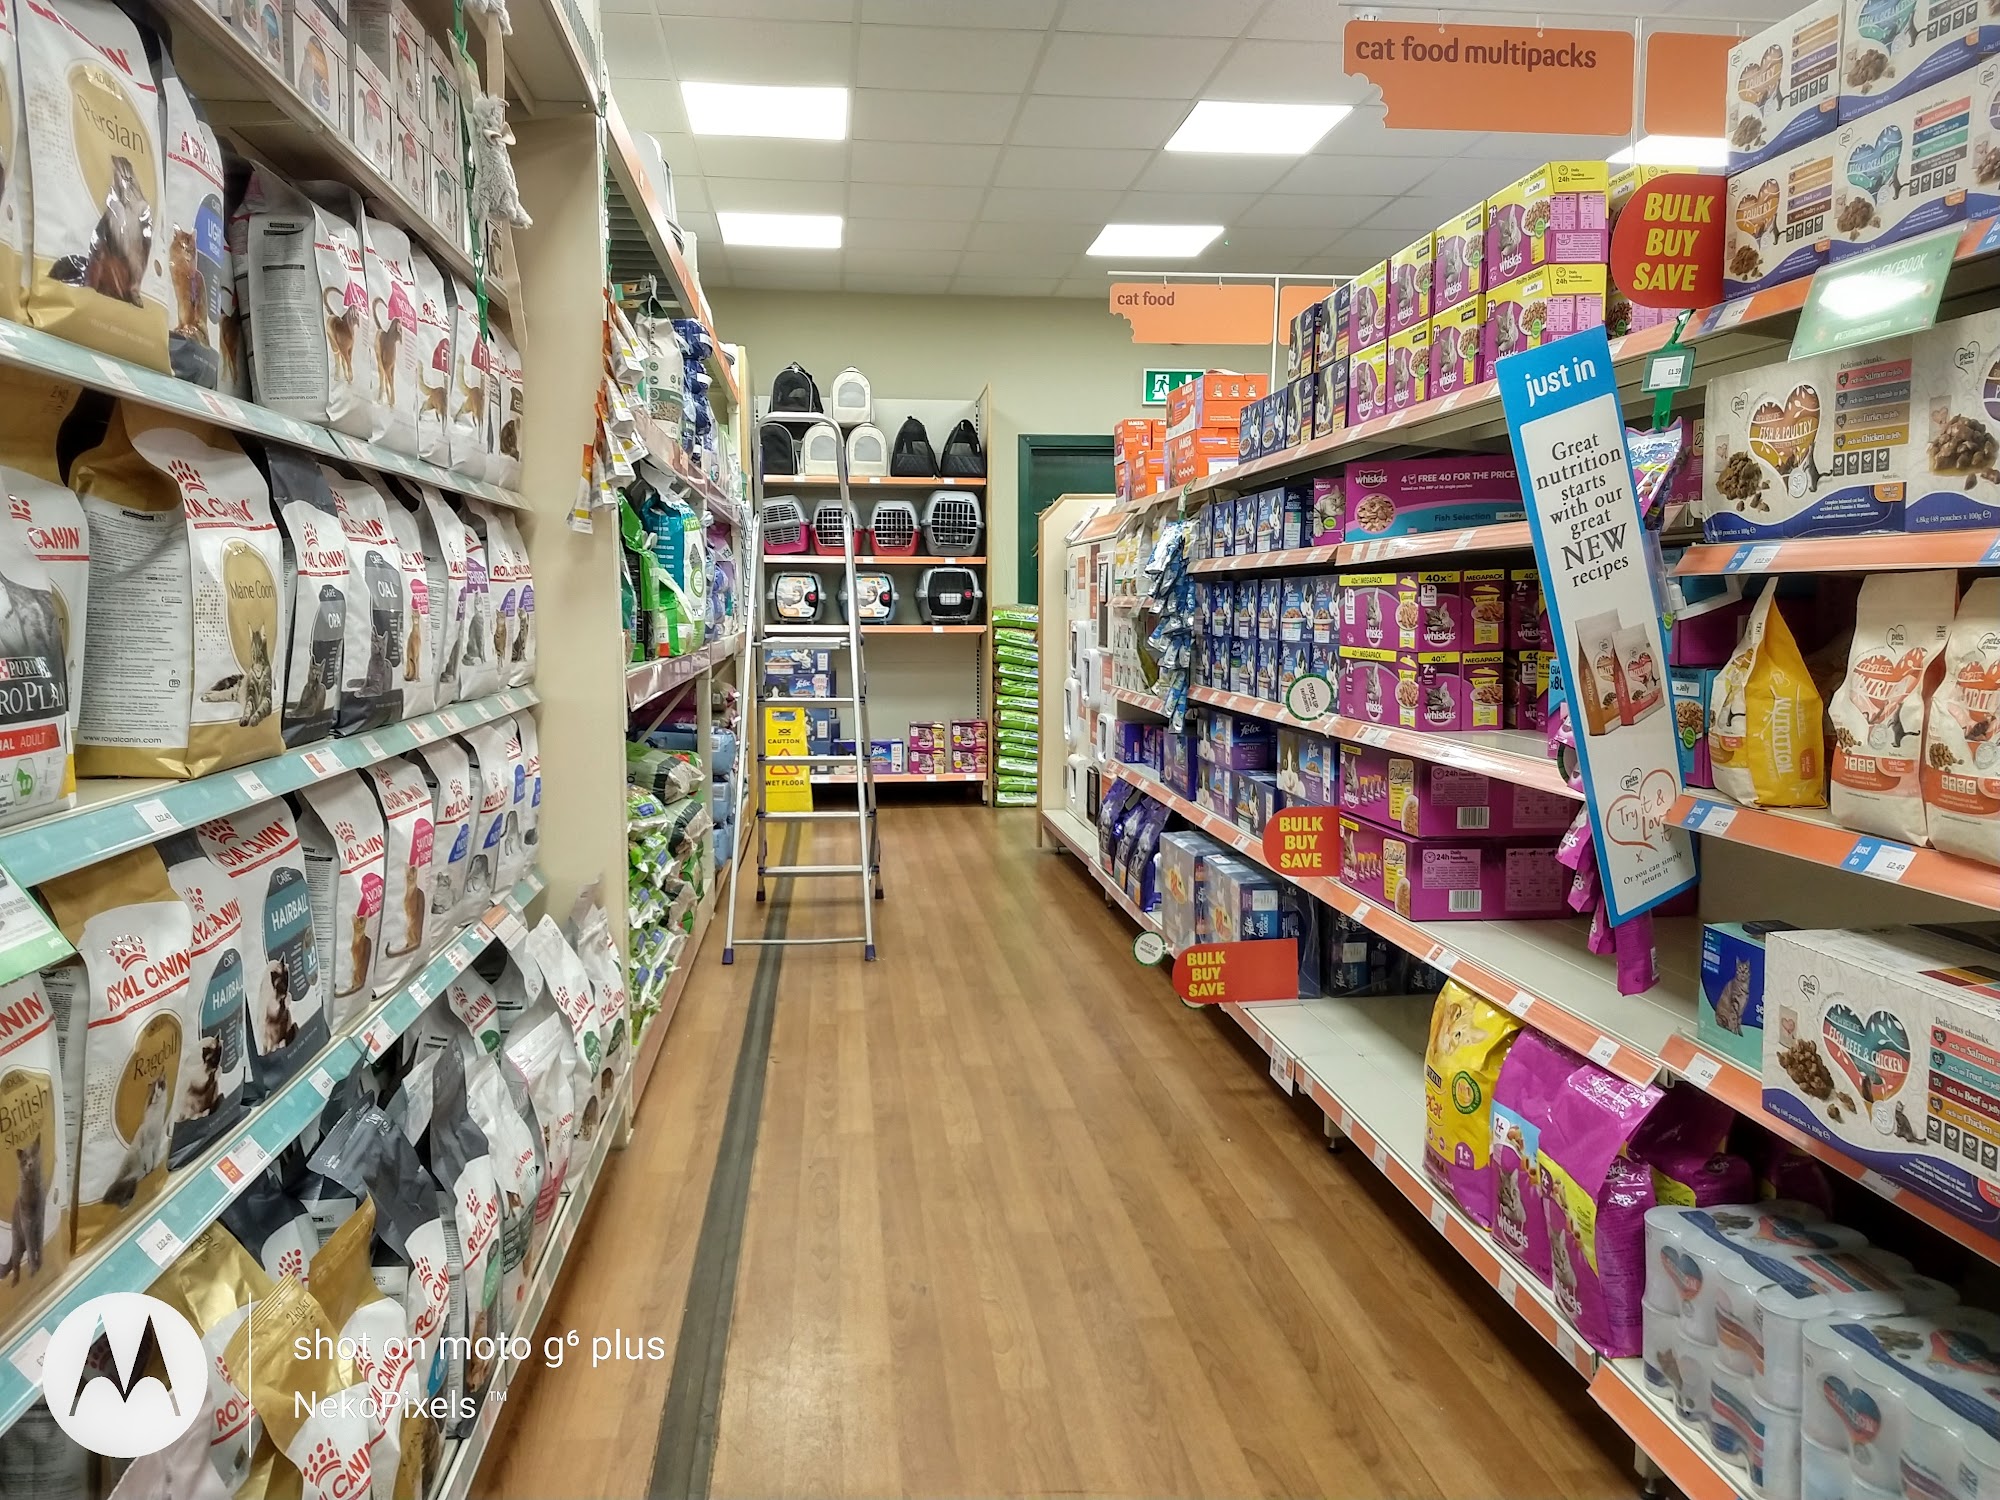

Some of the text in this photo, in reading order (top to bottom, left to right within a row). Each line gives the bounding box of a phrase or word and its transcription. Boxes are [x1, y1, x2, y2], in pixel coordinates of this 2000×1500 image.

[1355, 35, 1598, 72] cat food multipacks
[1745, 68, 1775, 90] POULTRY
[77, 93, 145, 154] Persian
[1557, 176, 1570, 184] 24h
[1643, 192, 1715, 224] BULK
[1743, 200, 1772, 220] POULTRY
[1645, 228, 1700, 257] BUY
[1555, 278, 1568, 286] 24h
[1632, 262, 1699, 292] SAVE
[1116, 290, 1175, 306] cat food
[1959, 351, 1975, 361] pets
[1524, 356, 1597, 408] just in
[1863, 369, 1888, 382] Salmon
[1760, 418, 1813, 440] FISH & POULTRY
[1551, 432, 1600, 461] Great
[1861, 433, 1885, 444] Chicken
[1401, 470, 1516, 484] 4 FREE 40 FOR THE PRICE
[1535, 448, 1622, 491] nutrition
[1355, 474, 1388, 485] whiskas
[1561, 472, 1607, 501] starts
[1549, 486, 1623, 525] with our
[1434, 512, 1491, 522] Fish Selection
[1570, 508, 1612, 541] great
[1939, 514, 1962, 523] pouches
[26, 526, 81, 550] CANIN
[1561, 522, 1627, 571] NEW
[1425, 574, 1448, 583] 40x
[1465, 573, 1503, 581] MEGAPACK
[1572, 554, 1629, 588] recipes
[229, 581, 276, 599] Maine Coon
[324, 588, 337, 598] CARE
[1422, 585, 1435, 595] 1+
[1515, 582, 1529, 591] 7+
[1423, 630, 1456, 643] whiskas
[1891, 632, 1905, 642] pets
[1464, 655, 1503, 664] MEGAPACK
[1523, 663, 1536, 672] 1+
[1422, 664, 1436, 674] 7+
[1860, 662, 1893, 674] COMPLETE
[25, 680, 66, 713] PLAN
[1306, 682, 1317, 700] STOCK
[1423, 710, 1457, 722] whiskas
[1241, 723, 1261, 737] felix
[1772, 696, 1794, 775] NUTRITION
[20, 732, 46, 748] ADULT
[83, 734, 162, 745] www.royalcanin.com
[1624, 775, 1639, 786] pets
[1617, 788, 1666, 831] Try it &
[1279, 816, 1324, 832] BULK
[1642, 808, 1672, 842] Lov
[243, 821, 291, 854] CANIN
[1284, 835, 1318, 850] BUY
[1436, 853, 1450, 862] 24h
[1853, 843, 1872, 857] just
[1280, 852, 1322, 869] SAVE
[1623, 851, 1683, 885] Or you can simply
[1848, 856, 1860, 866] in
[1886, 861, 1906, 872] £2.49
[1641, 867, 1670, 886] return it
[271, 894, 309, 932] HAIRBALL
[1186, 951, 1226, 967] BULK
[144, 948, 192, 989] CANIN
[1191, 966, 1222, 982] BUY
[1188, 980, 1225, 997] SAVE
[1802, 981, 1817, 992] pets
[1935, 1016, 1964, 1035] Delicious
[133, 1033, 178, 1081] Ragdoll
[1845, 1036, 1862, 1056] BEEF
[1862, 1047, 1870, 1061] &
[1870, 1050, 1904, 1073] CHICKEN
[1966, 1046, 1995, 1066] Salmon
[1965, 1068, 1984, 1084] Trout
[1964, 1089, 1981, 1106] Beef
[0, 1084, 48, 1135] British
[1495, 1117, 1505, 1133] 1+
[1963, 1112, 1993, 1135] Chicken
[1458, 1145, 1471, 1161] 1+
[1497, 1213, 1529, 1249] whiskas
